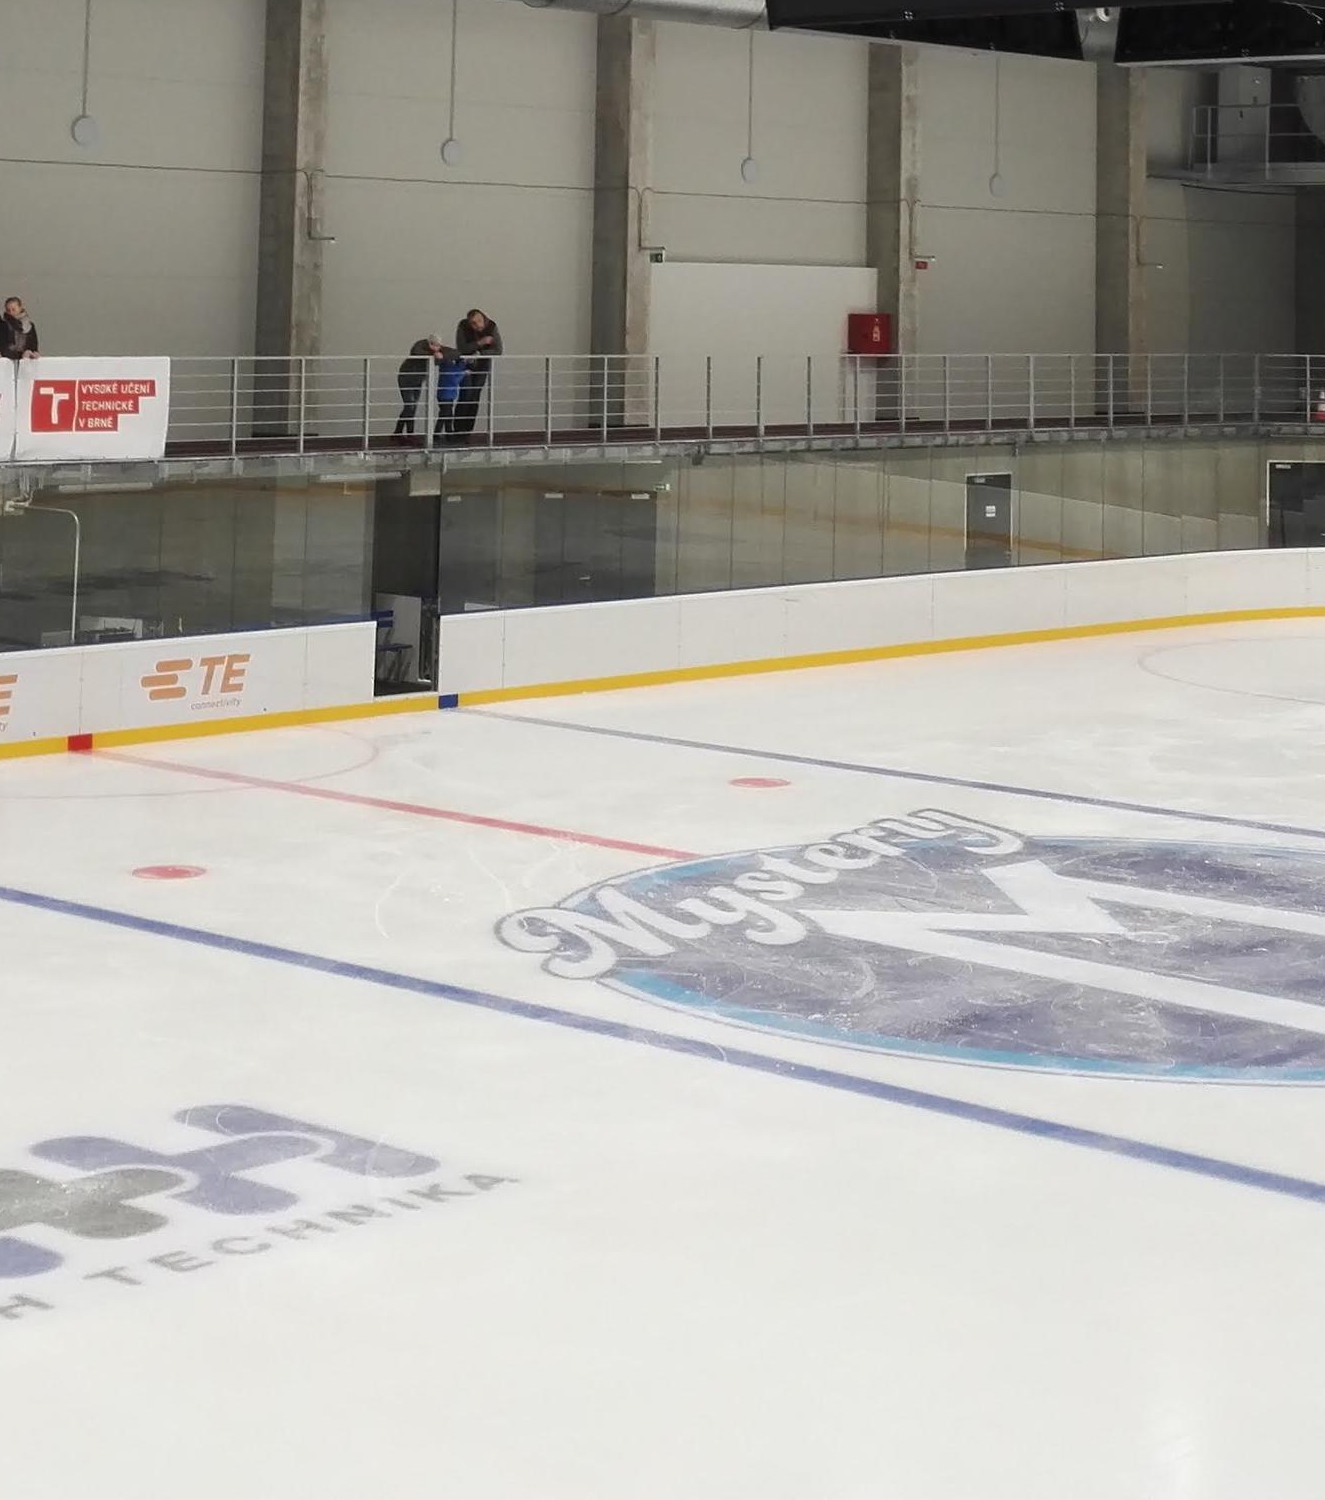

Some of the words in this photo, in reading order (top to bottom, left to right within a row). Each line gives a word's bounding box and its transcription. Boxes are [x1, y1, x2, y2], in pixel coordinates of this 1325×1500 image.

[81, 383, 118, 394] VYSOKÉ
[122, 382, 150, 394] UČENÍ
[81, 400, 134, 411] TECHNICKÉ
[200, 653, 251, 695] TE
[191, 697, 242, 711] connectivity
[497, 807, 1027, 980] Mystery
[84, 1171, 521, 1288] TECHNIKA
